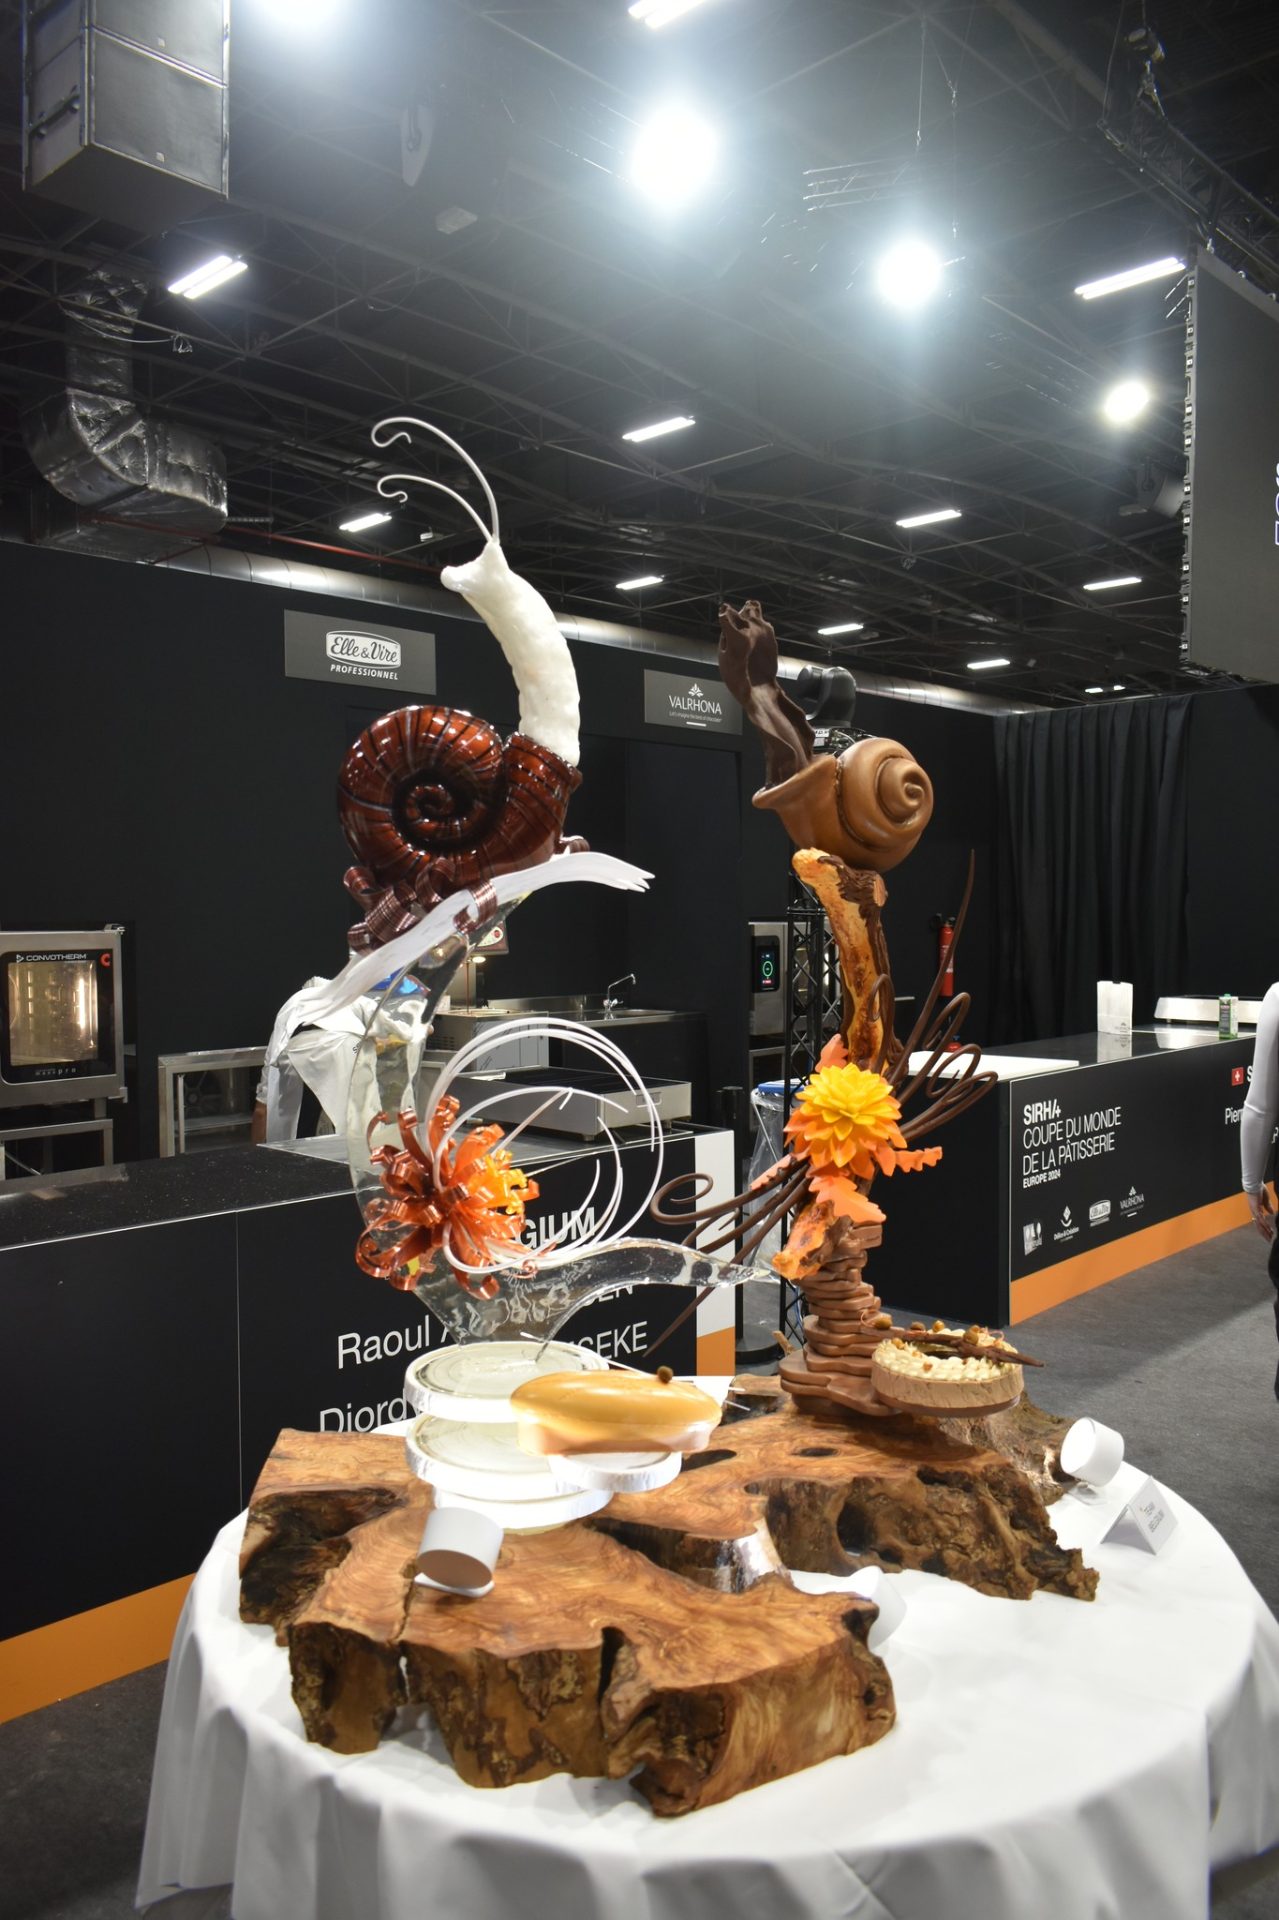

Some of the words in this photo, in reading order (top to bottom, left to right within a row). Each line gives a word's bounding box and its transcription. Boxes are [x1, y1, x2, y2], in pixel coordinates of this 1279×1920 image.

[330, 664, 398, 680] PROFESSIONNEL
[668, 694, 722, 715] VALRHONA
[26, 953, 87, 962] CONVOTHERM
[1023, 1120, 1064, 1150] COUPE
[1065, 1116, 1082, 1138] DU
[1083, 1106, 1122, 1134] MONDE
[1023, 1152, 1039, 1176] DE
[1041, 1148, 1057, 1171] LA
[1058, 1131, 1115, 1166] PÂTISSERIE
[1022, 1172, 1048, 1188] EUROPE
[1047, 1168, 1062, 1181] 2024
[516, 1206, 596, 1249] GIUM
[337, 1314, 430, 1369] Raoul
